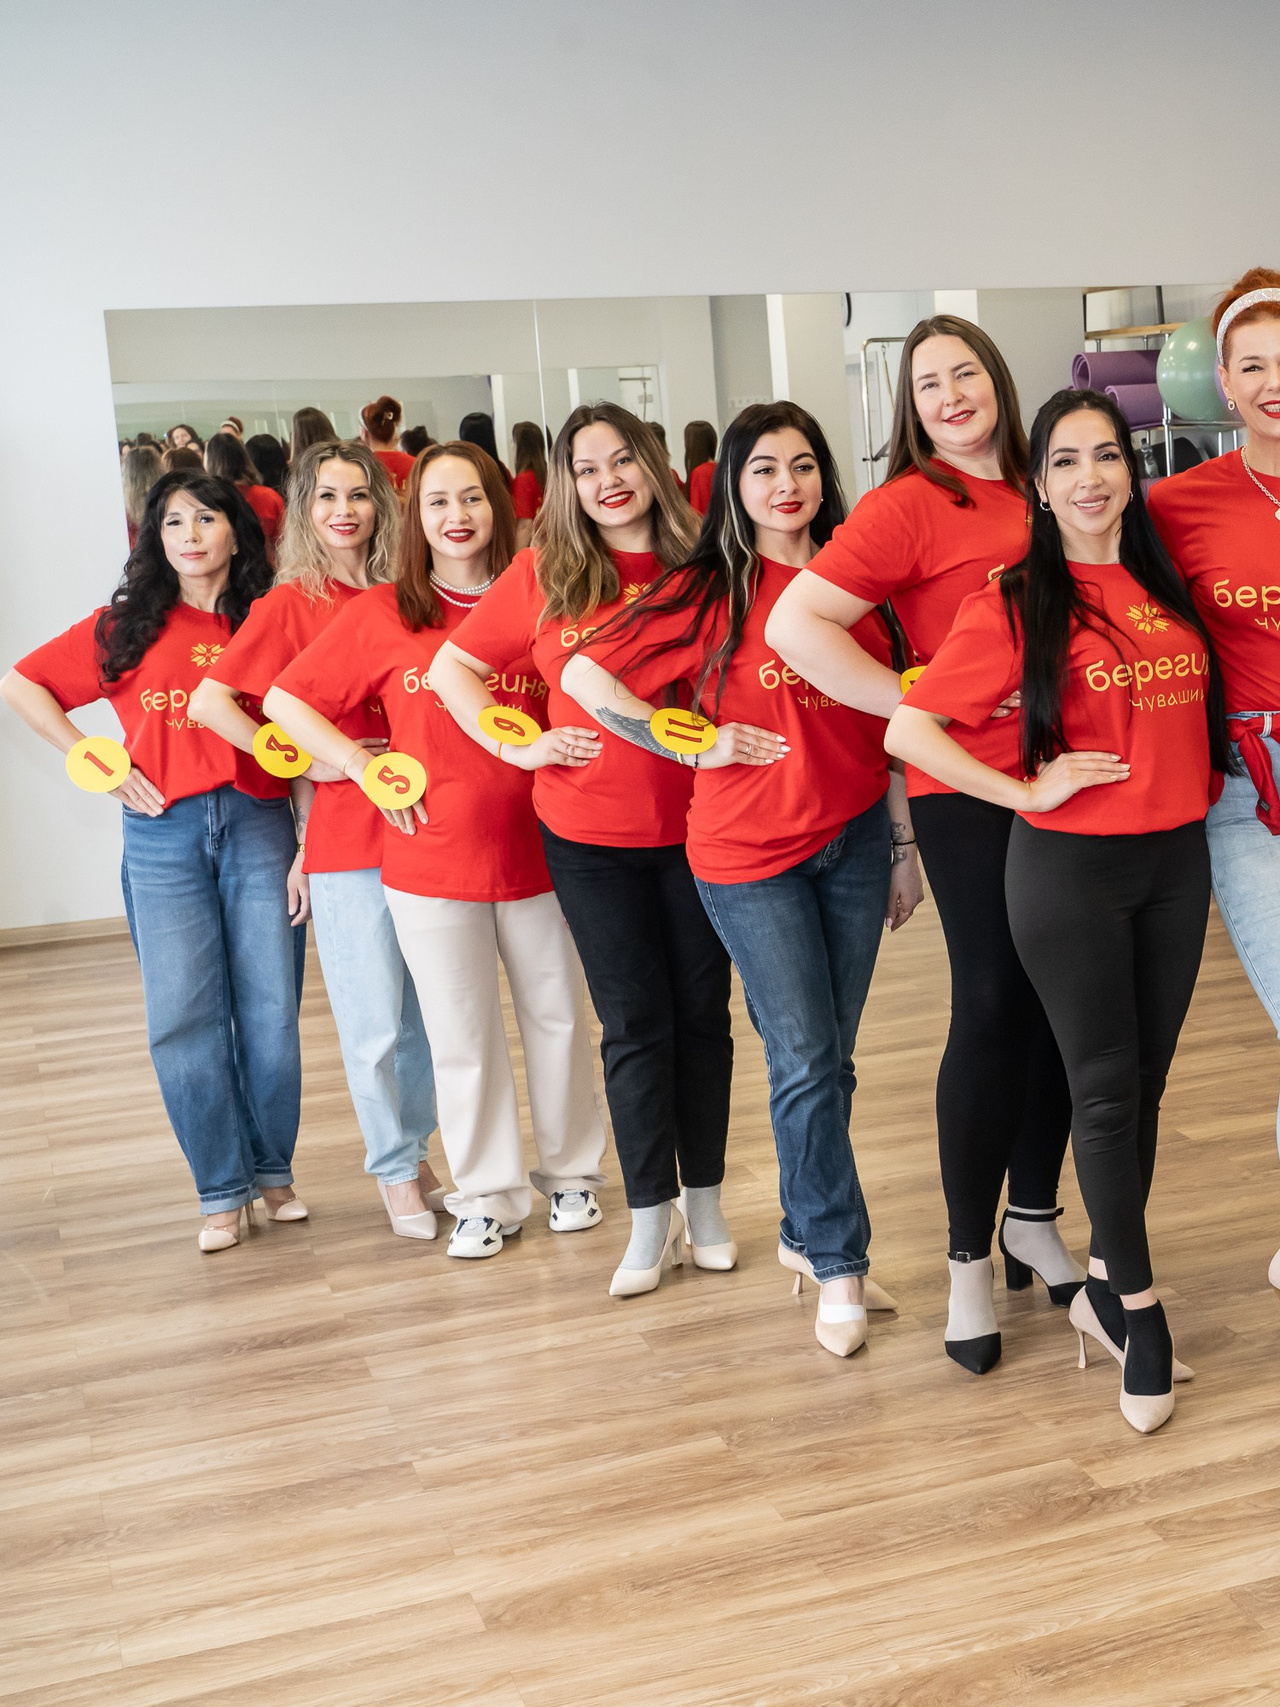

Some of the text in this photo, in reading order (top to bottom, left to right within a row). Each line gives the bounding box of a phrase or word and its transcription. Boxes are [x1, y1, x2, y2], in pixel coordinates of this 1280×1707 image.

[1085, 652, 1209, 692] береги
[664, 717, 705, 743] 11
[84, 750, 115, 777] 1
[377, 764, 411, 795] 5
